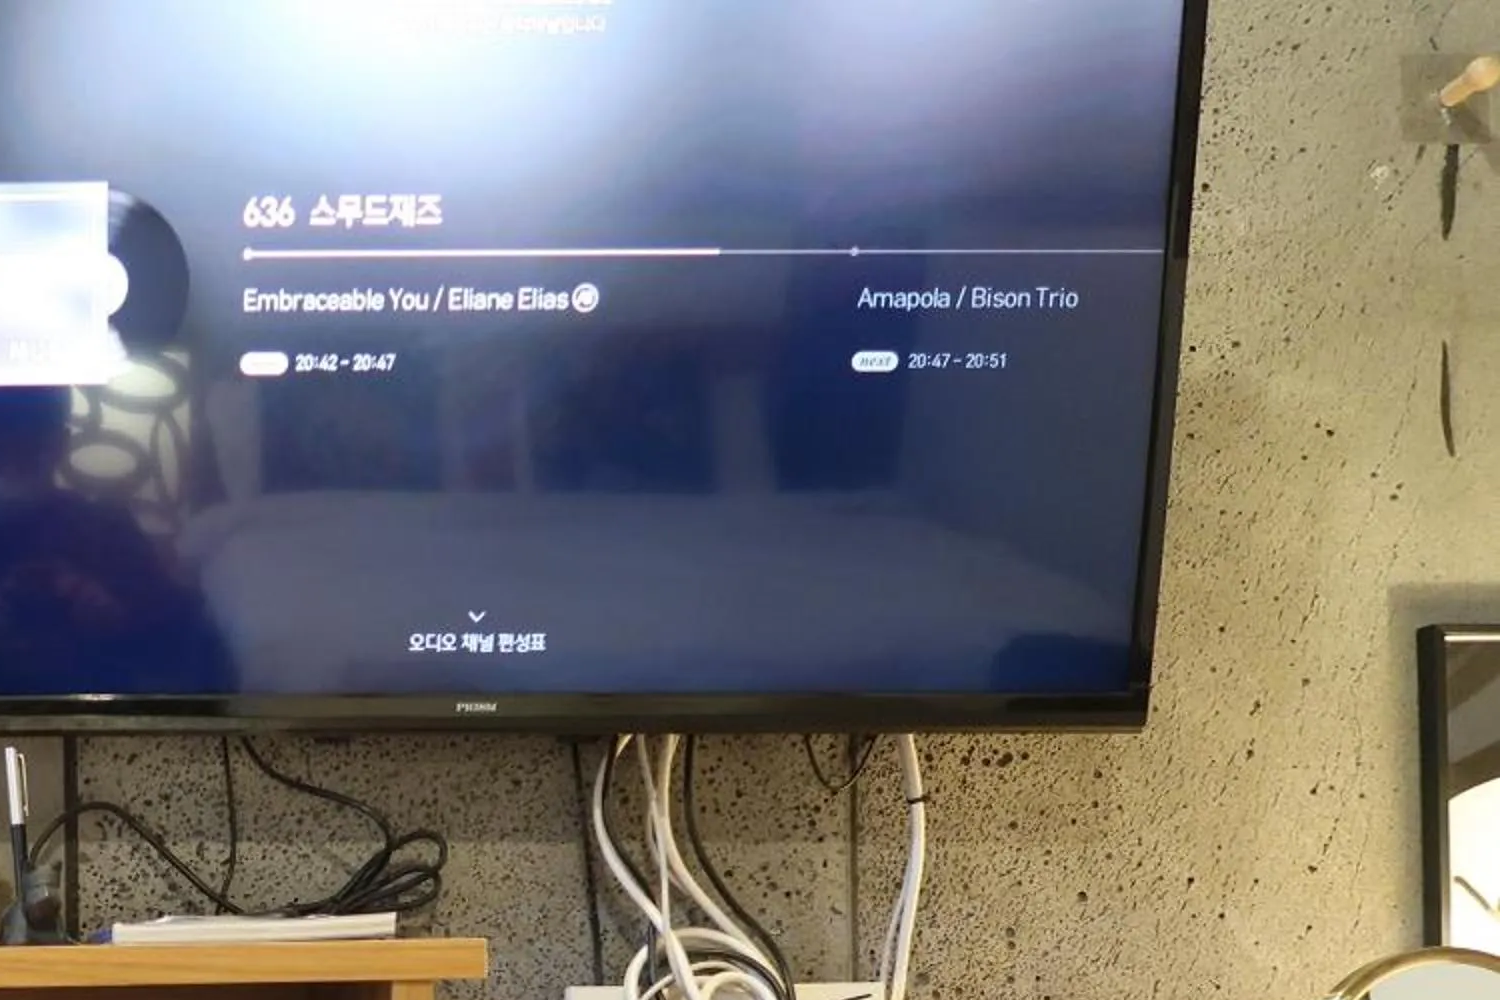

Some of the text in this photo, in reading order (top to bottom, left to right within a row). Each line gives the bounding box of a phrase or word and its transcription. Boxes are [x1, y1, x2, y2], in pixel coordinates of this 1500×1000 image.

[243, 194, 443, 229] 636 스무드재즈
[243, 287, 384, 312] Embraceable
[388, 288, 429, 311] You
[448, 286, 513, 311] Eliane
[517, 286, 569, 311] Elias
[857, 287, 951, 311] Amapola
[970, 287, 1031, 309] Bison
[1036, 286, 1079, 309] Trio
[295, 353, 338, 372] 20:42
[353, 353, 397, 372] 20:47
[907, 352, 951, 369] 20:47
[965, 352, 1008, 369] 20:51
[408, 632, 547, 652] 오디오 채널 편성표
